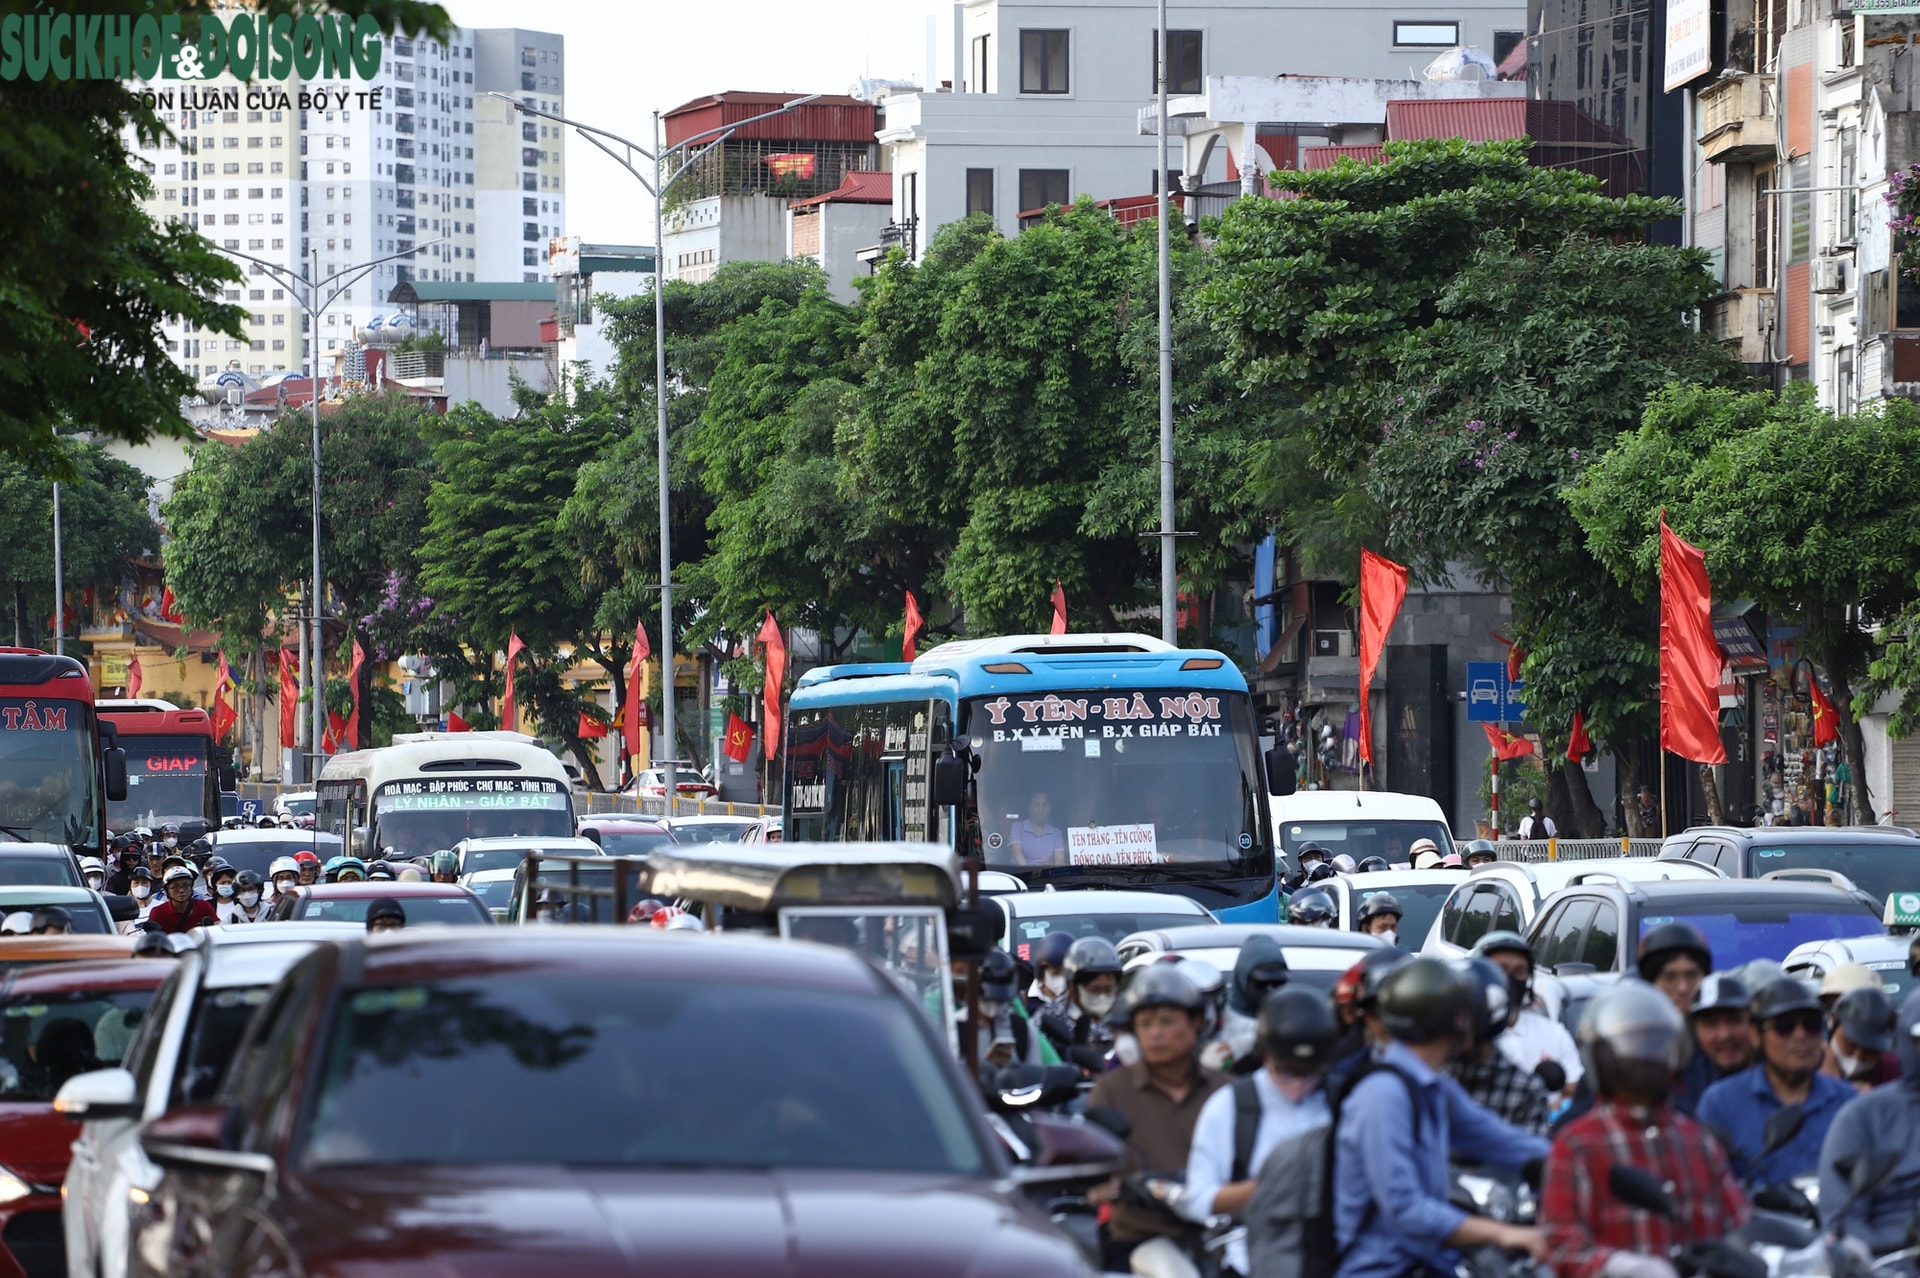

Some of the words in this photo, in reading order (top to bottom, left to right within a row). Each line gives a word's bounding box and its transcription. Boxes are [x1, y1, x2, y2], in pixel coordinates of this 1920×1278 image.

[2, 701, 67, 731] TÂM
[984, 696, 1011, 725] Ý
[1159, 692, 1222, 724] NỘI
[993, 728, 1023, 743] B.X
[1047, 723, 1084, 740] YÊN
[1103, 724, 1134, 738] B.X
[1139, 723, 1182, 738] GIÁP
[1188, 723, 1222, 737] BÁT
[403, 782, 422, 796] MẠC
[447, 780, 470, 792] PHÚC
[495, 780, 514, 793] MẠC
[394, 796, 412, 809] LÝ
[418, 795, 461, 808] NHÂN
[479, 795, 516, 808] GIÁP
[521, 795, 550, 807] BÁT
